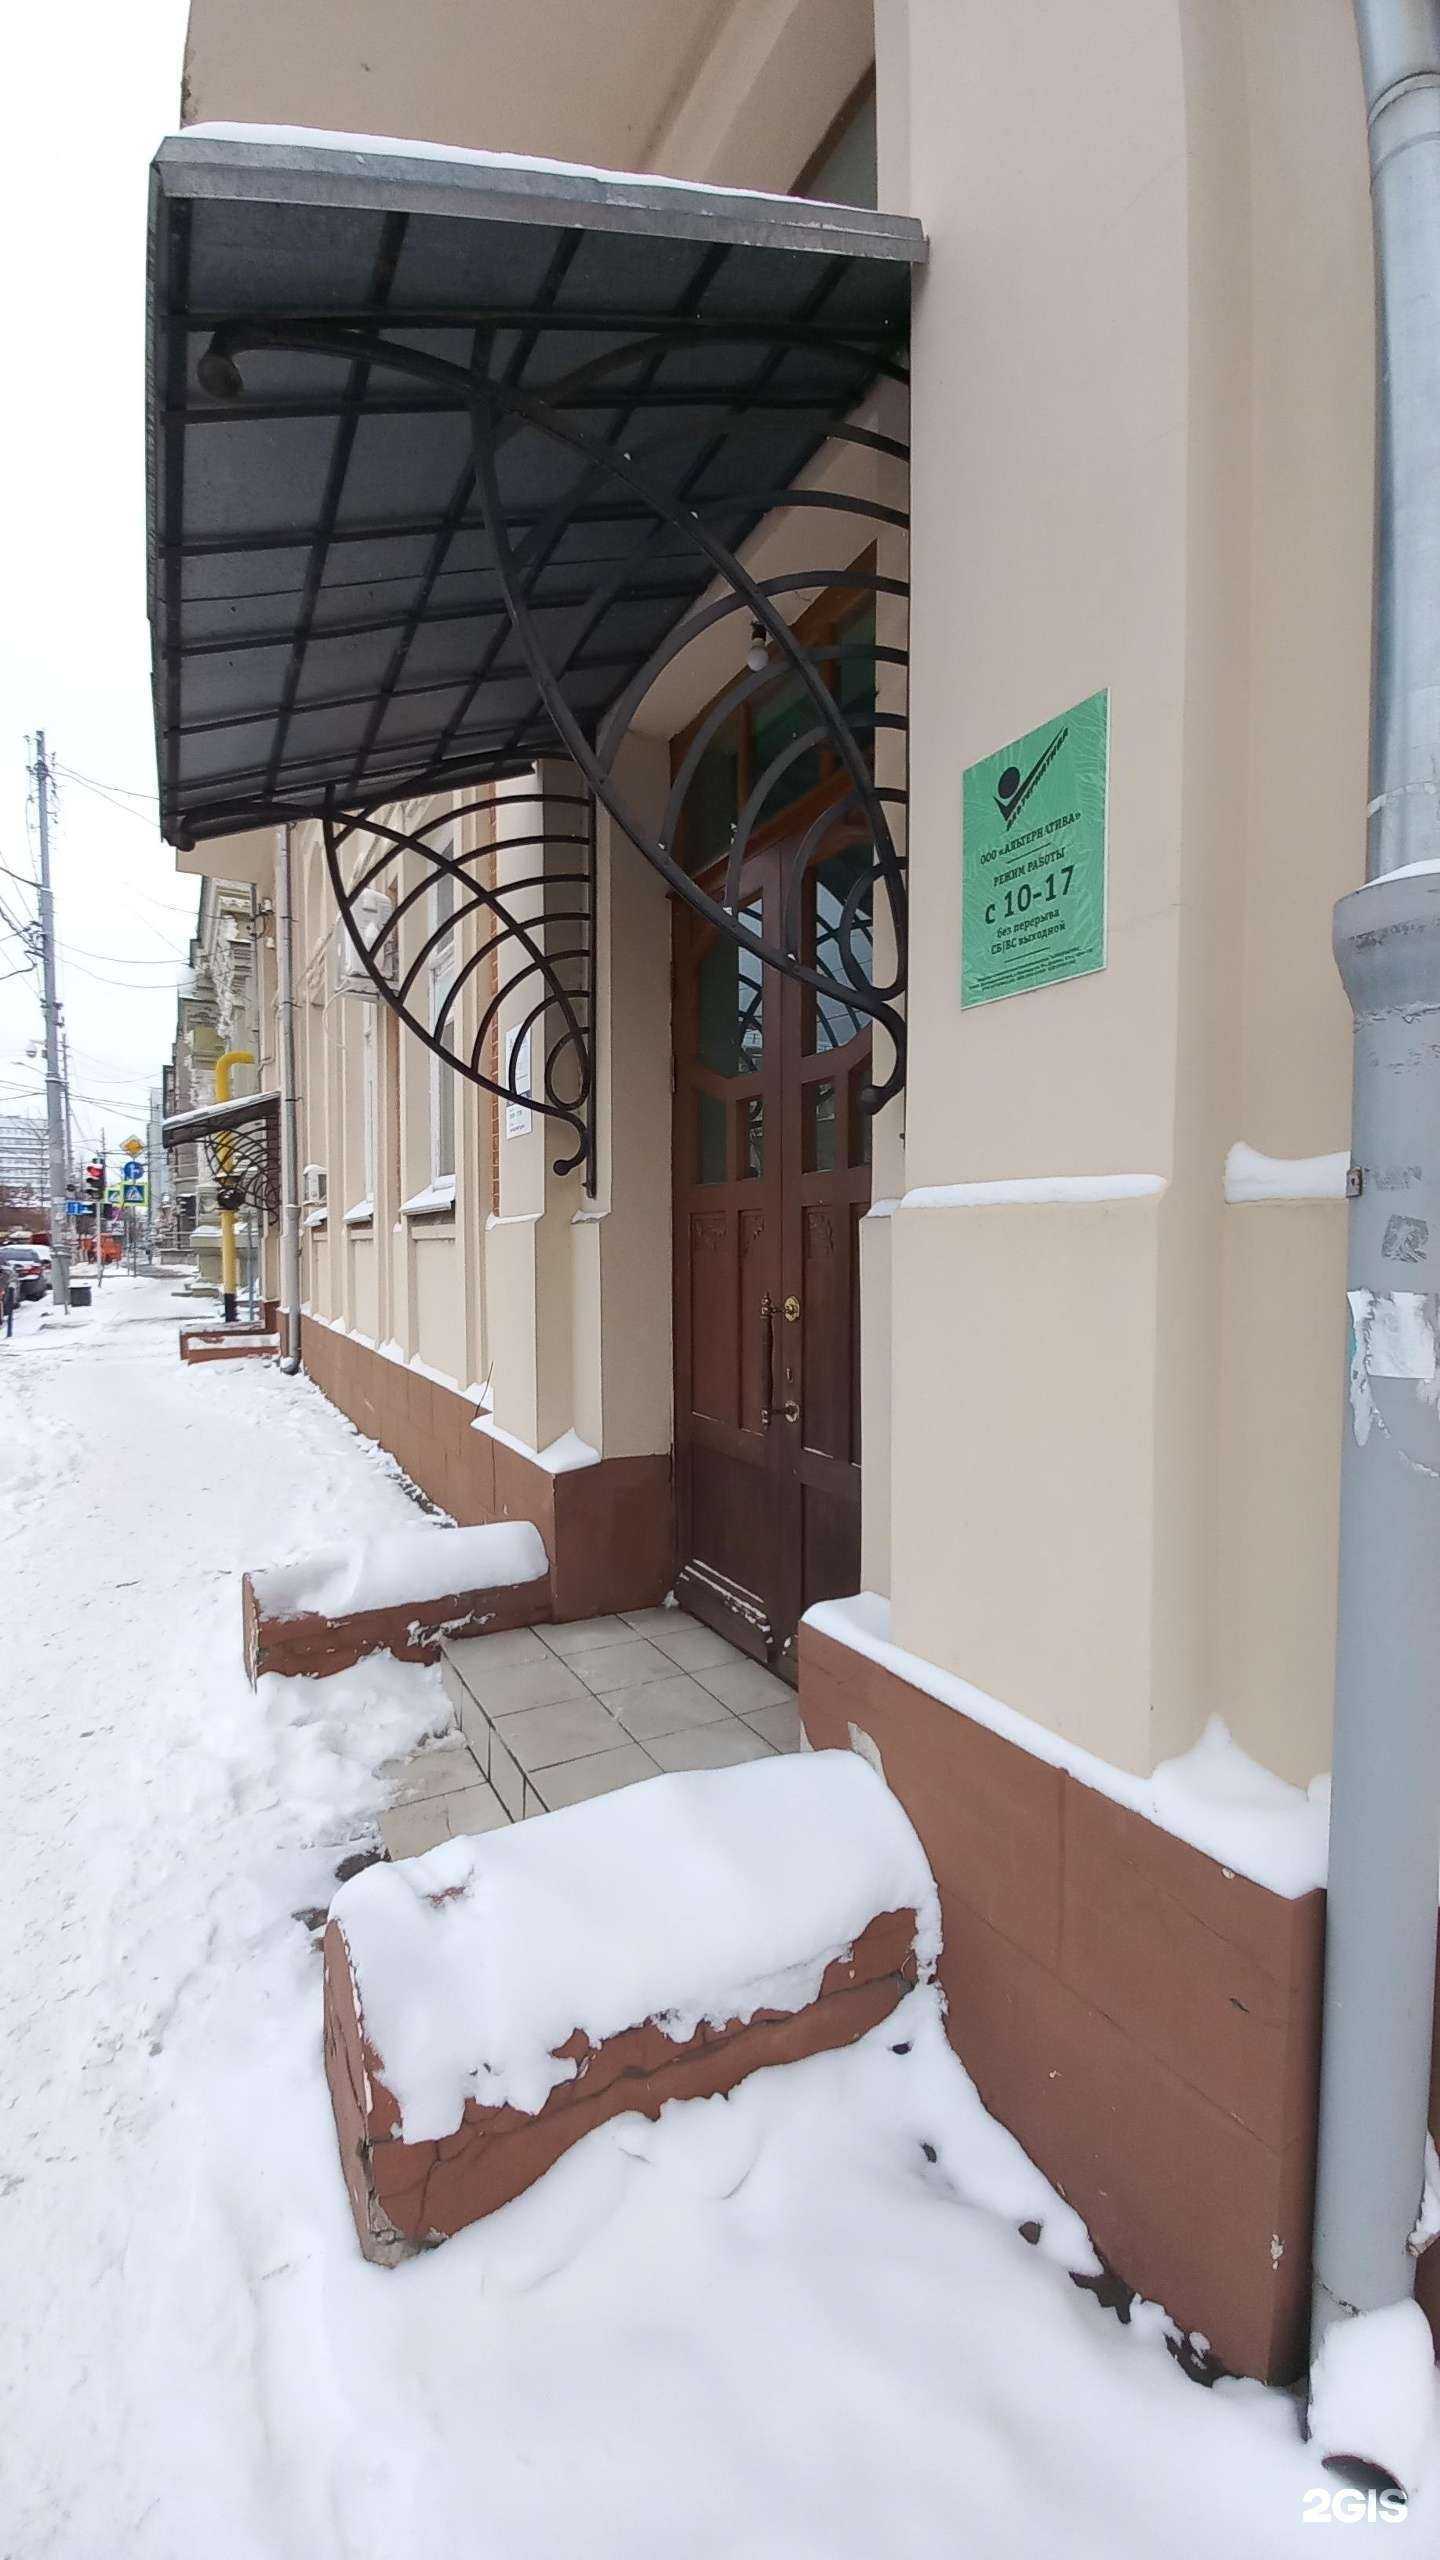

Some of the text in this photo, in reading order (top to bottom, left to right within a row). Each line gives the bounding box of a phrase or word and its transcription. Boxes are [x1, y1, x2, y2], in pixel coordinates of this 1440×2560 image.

[980, 849, 998, 865] ООО
[993, 848, 1066, 887] РЕЖИМ РАБОТЫ
[1004, 864, 1076, 918] 10-17
[996, 908, 1061, 938] без перерыва
[1018, 920, 1066, 945] выходной
